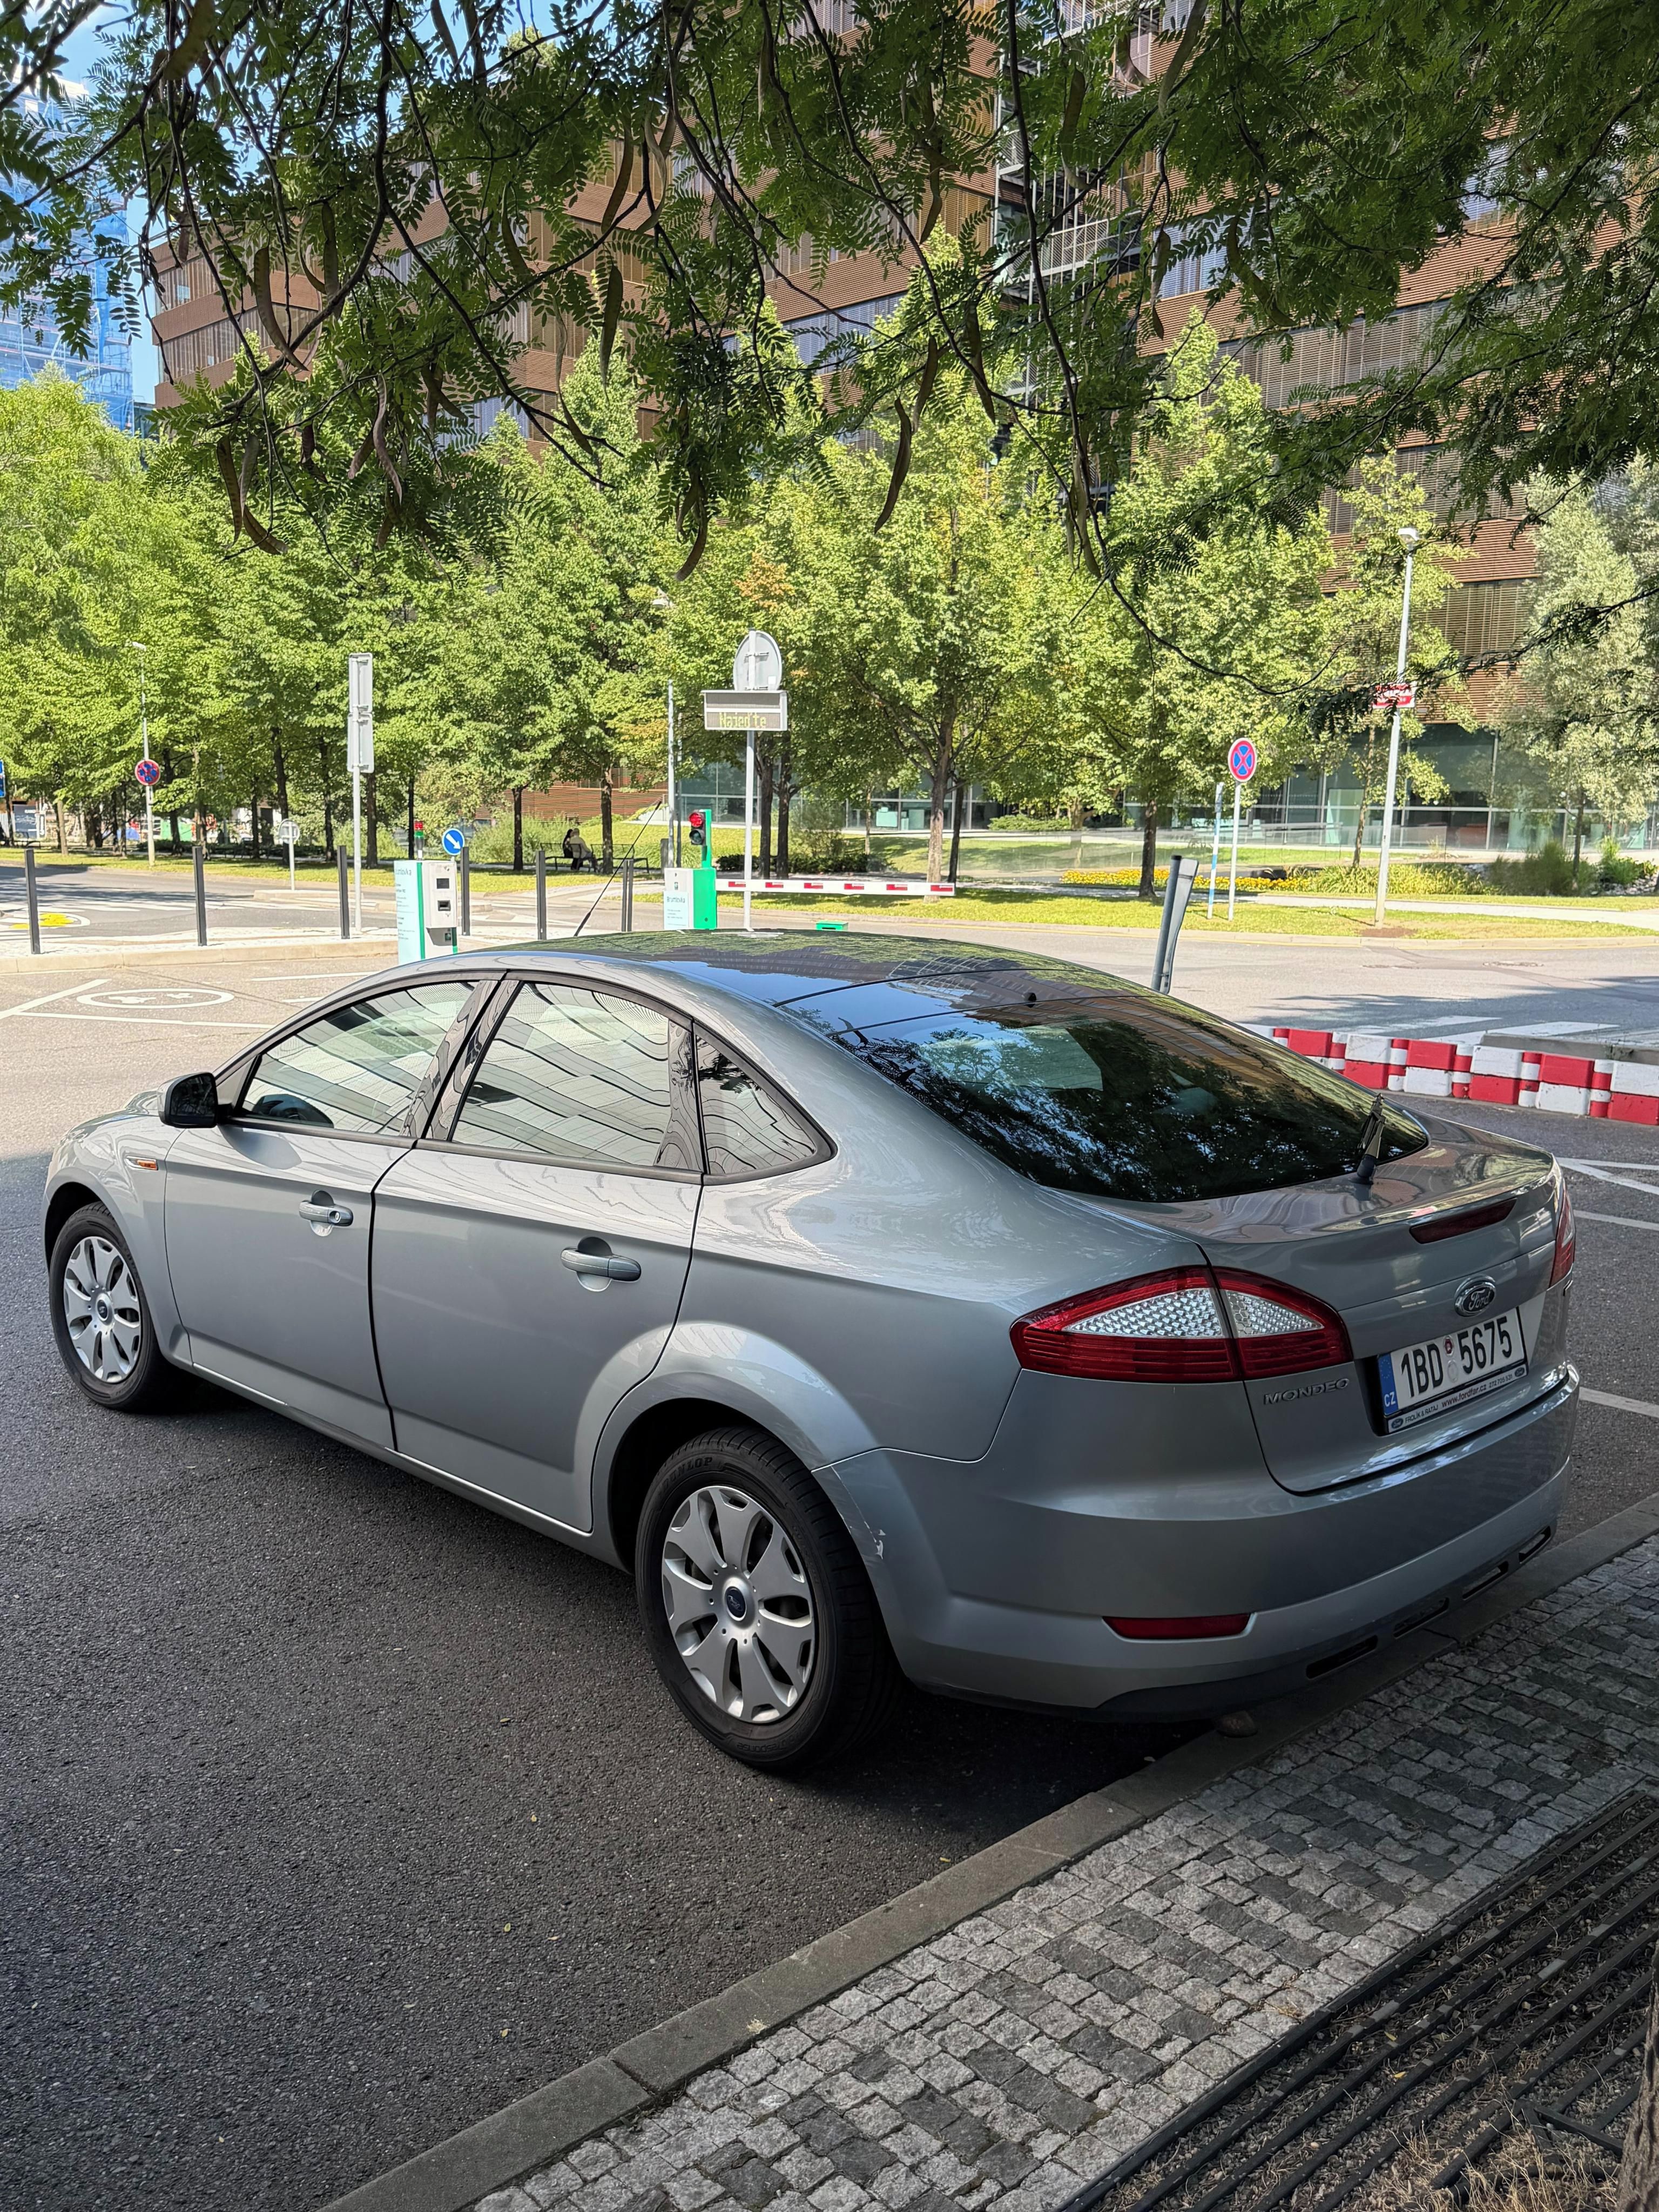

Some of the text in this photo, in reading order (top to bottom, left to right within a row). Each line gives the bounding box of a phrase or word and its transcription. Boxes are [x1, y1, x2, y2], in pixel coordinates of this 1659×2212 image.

[1468, 1289, 1491, 1311] Ford
[1401, 1316, 1512, 1398] 1BD 5675
[1264, 1378, 1350, 1405] MONDEO
[1384, 1392, 1396, 1407] CZ
[1425, 1405, 1439, 1415] RATAJ
[1441, 1384, 1487, 1408] www.fordfar.cz
[1489, 1380, 1497, 1388] 272
[662, 1457, 713, 1490] DUNLOP
